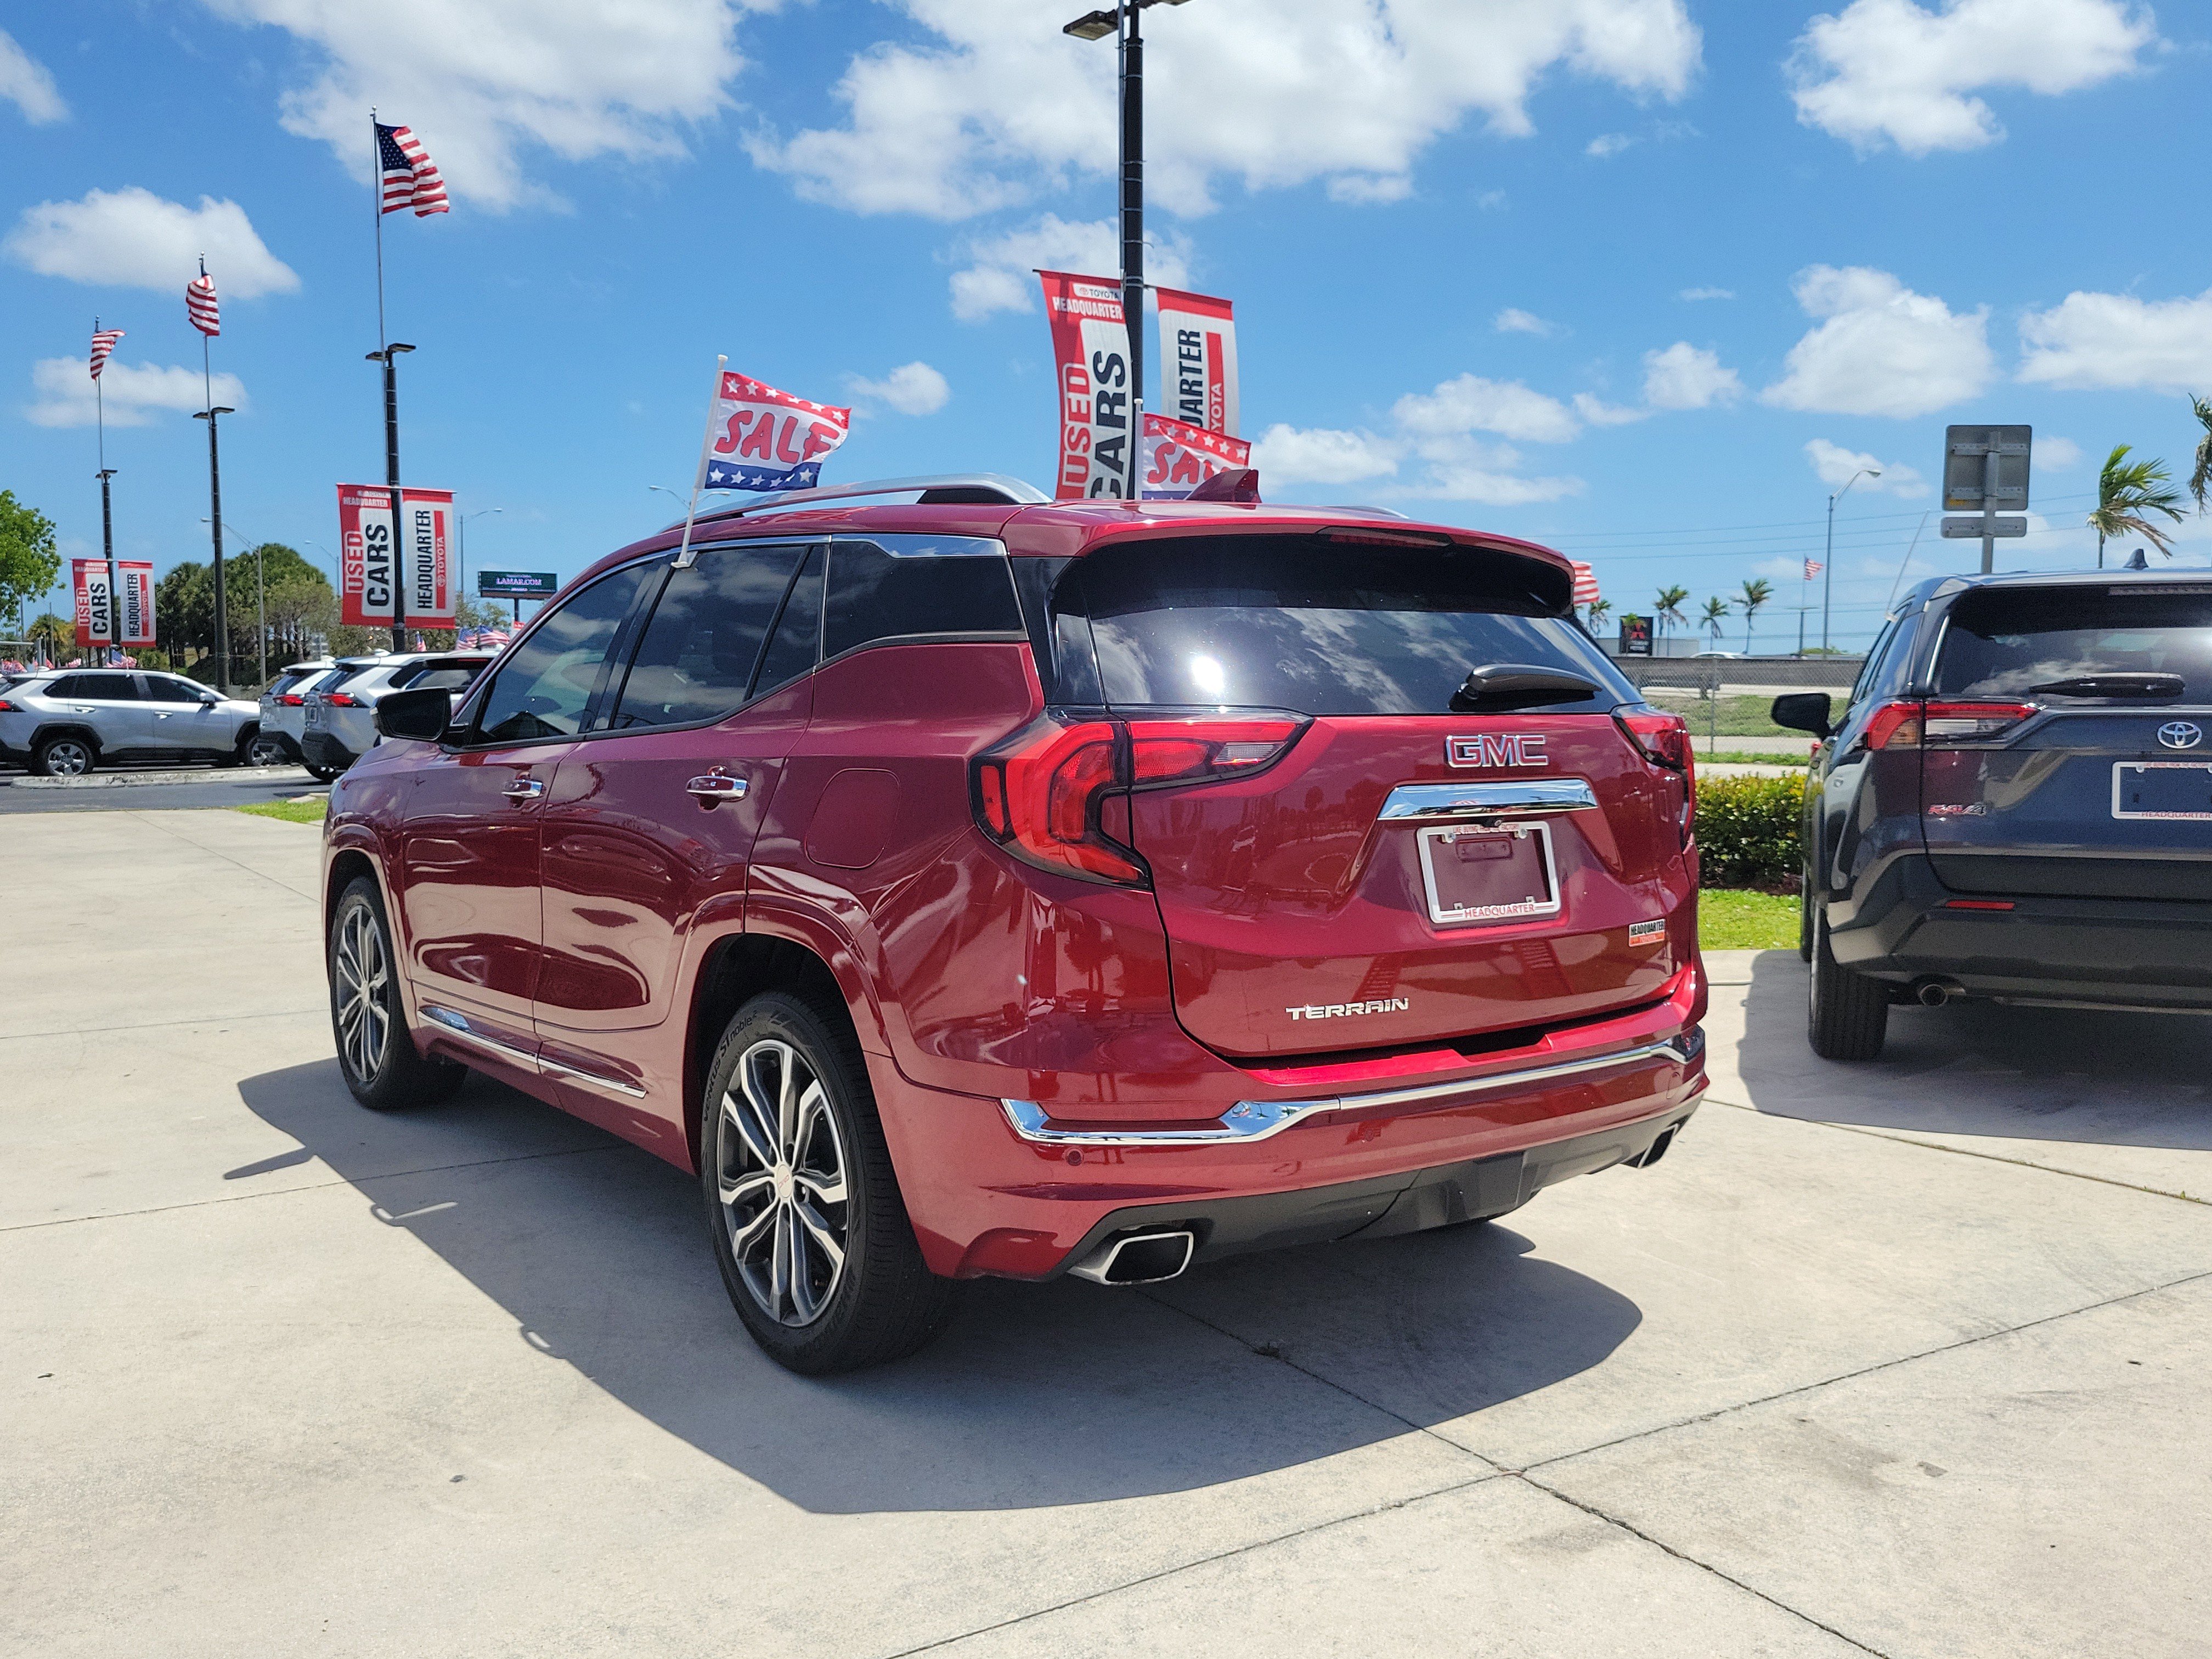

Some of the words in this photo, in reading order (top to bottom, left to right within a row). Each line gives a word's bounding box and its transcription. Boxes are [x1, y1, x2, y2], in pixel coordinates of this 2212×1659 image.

[1052, 296, 1123, 320] HEADQUARTER
[1090, 289, 1119, 300] TOYOTA
[1063, 364, 1091, 486] USED
[1211, 382, 1222, 432] YOTA
[343, 496, 388, 507] HEADQUARTER
[346, 532, 364, 593] USED
[365, 524, 390, 606] CARS
[415, 510, 435, 609] HEADQUARTER
[436, 537, 446, 577] TOYOTA
[76, 588, 91, 627] USED
[91, 583, 108, 634] CARS
[127, 573, 142, 636] HEADQUARTER
[1446, 735, 1549, 768] GMC
[1928, 804, 1987, 816] RAV4
[1464, 904, 1535, 918] HEADQUARTER
[1630, 921, 1664, 936] HEADQUARTER
[1285, 997, 1409, 1021] TERRAIN
